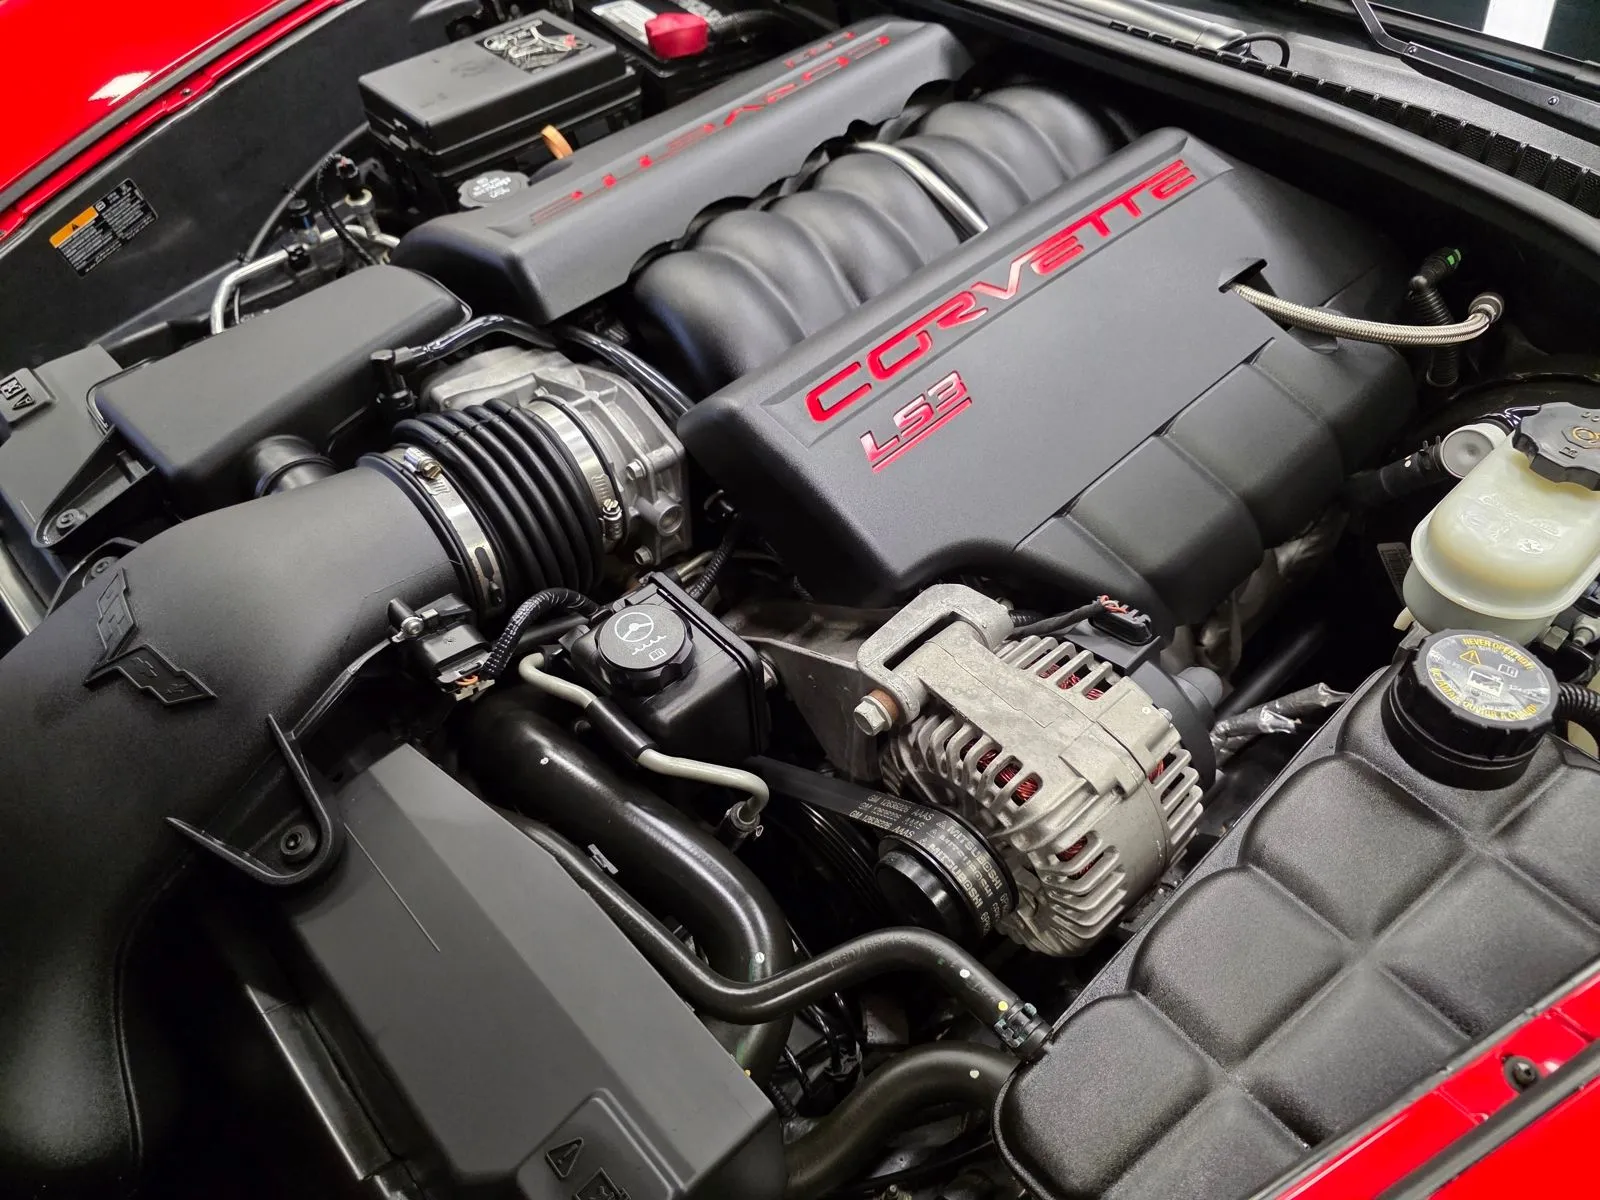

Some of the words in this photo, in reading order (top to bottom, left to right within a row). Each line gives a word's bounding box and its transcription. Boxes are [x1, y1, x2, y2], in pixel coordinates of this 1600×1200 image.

[805, 158, 1197, 424] CORVETTE
[859, 370, 970, 468] LS3
[1462, 637, 1491, 648] NEVER
[926, 843, 984, 909] MITSUBOSHI
[946, 825, 1003, 890] MITSUBOSHI
